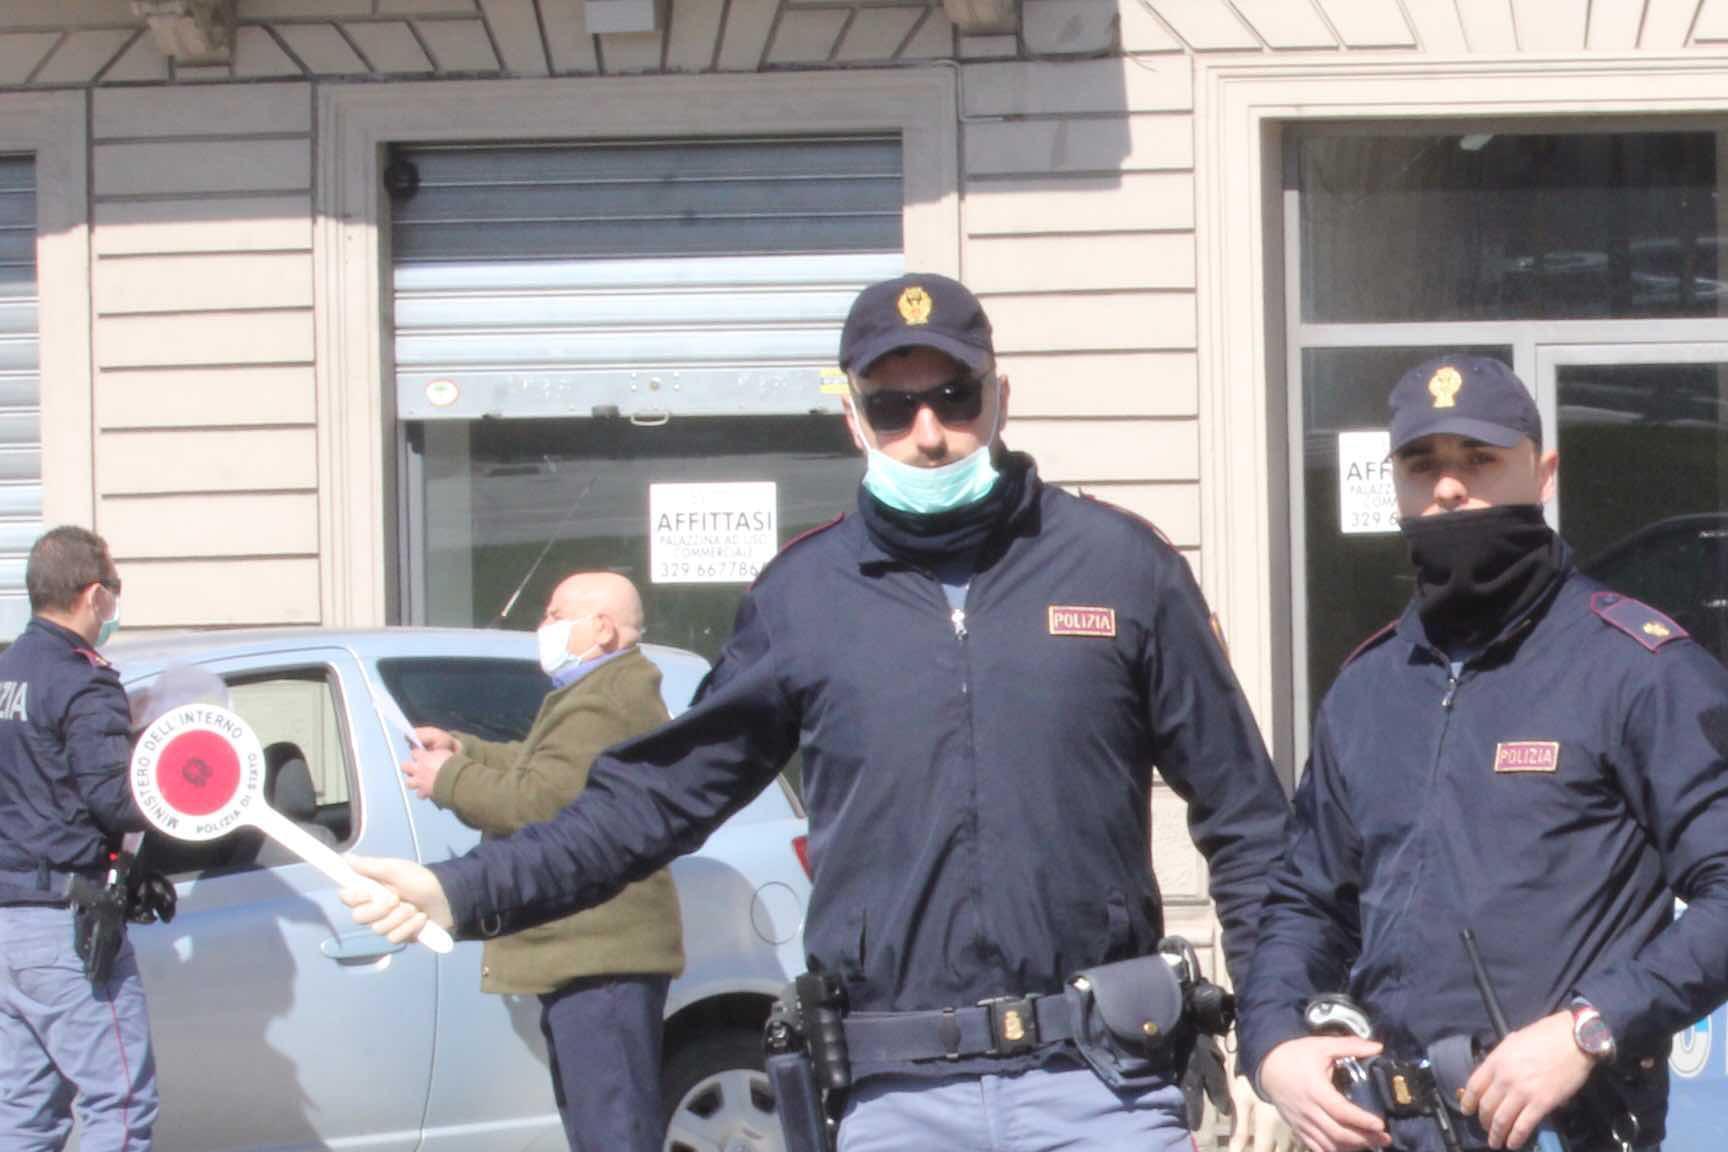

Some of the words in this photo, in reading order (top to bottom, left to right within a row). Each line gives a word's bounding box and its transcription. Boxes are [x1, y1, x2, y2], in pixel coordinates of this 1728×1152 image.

[657, 511, 772, 532] AFFITTASI
[661, 562, 689, 577] 329
[697, 560, 769, 577] 667786
[1055, 613, 1110, 629] POLIZIA
[1500, 747, 1553, 765] POLIZIA
[136, 756, 180, 830] MINISTERO
[178, 710, 243, 740] INTERNO
